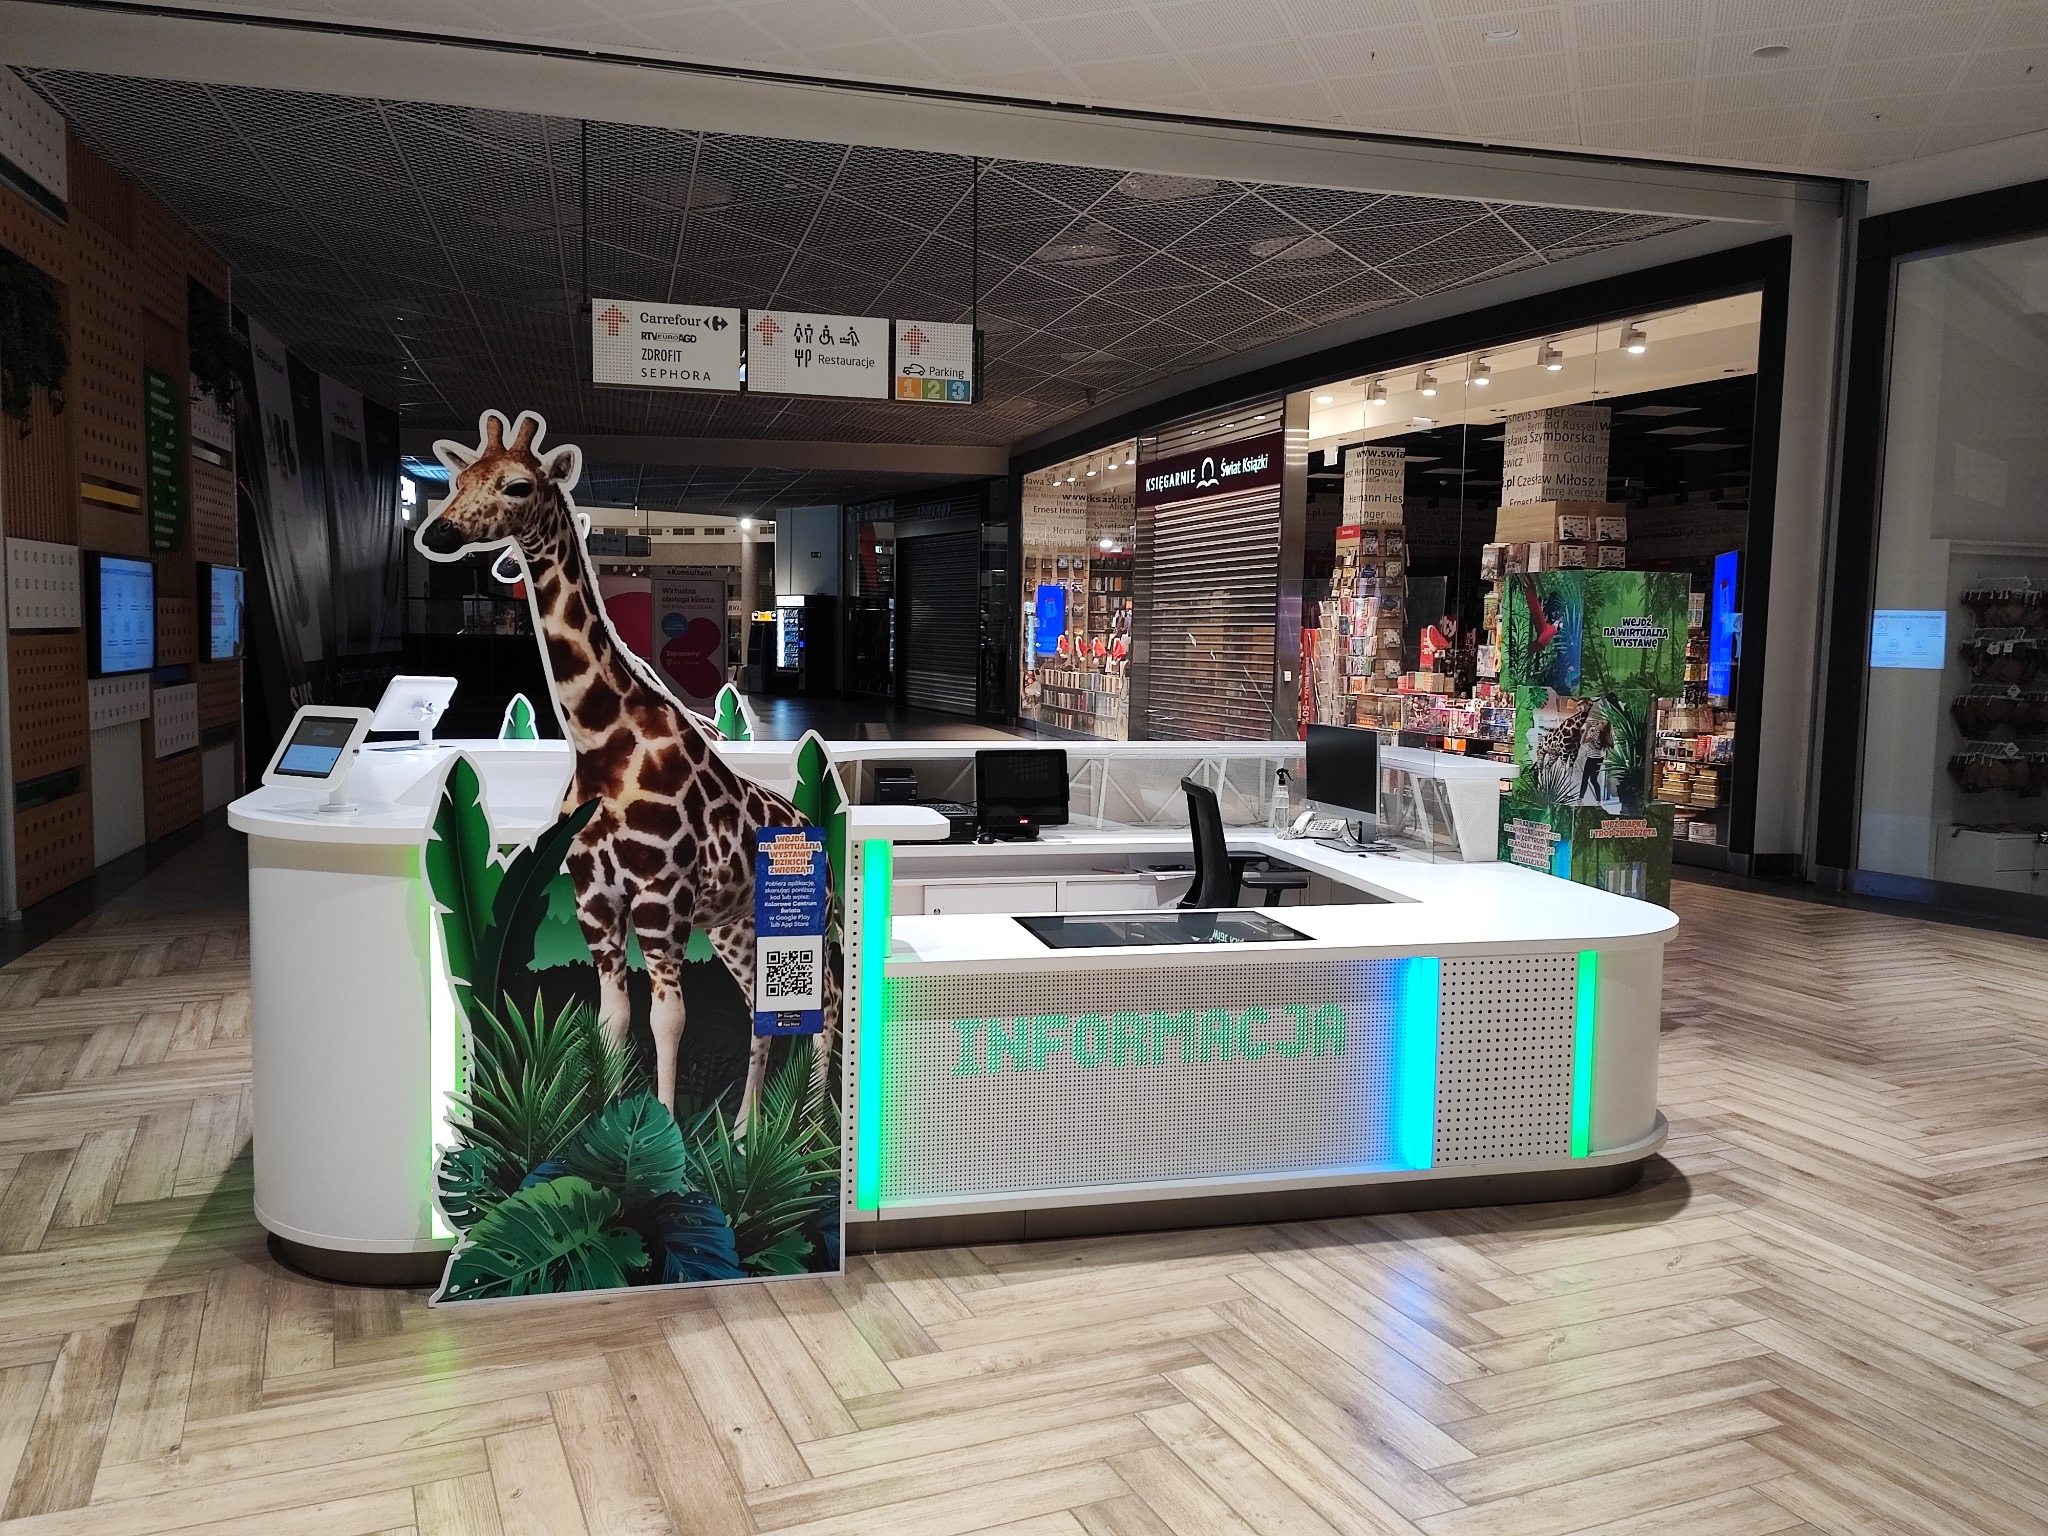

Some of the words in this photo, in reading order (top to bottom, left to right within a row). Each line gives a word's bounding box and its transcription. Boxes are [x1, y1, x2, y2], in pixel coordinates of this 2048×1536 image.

[640, 312, 702, 331] Carrefour
[641, 348, 682, 363] ZDROFIT
[818, 354, 875, 368] Restauracje
[641, 368, 711, 382] SEPHORA
[929, 366, 964, 379] Parking
[903, 378, 915, 398] 1
[927, 379, 940, 398] 2
[952, 381, 965, 400] 3
[1527, 420, 1560, 432] Bertrand
[1563, 420, 1598, 431] Russell
[1530, 430, 1595, 443] Szymborska
[1526, 452, 1559, 464] William
[1220, 457, 1241, 477] Świat
[1242, 453, 1269, 474] Książki
[1145, 468, 1196, 493] KSIĘGARNIE
[1517, 473, 1552, 487] Czesław
[1556, 473, 1595, 487] Miłosz
[1568, 486, 1605, 498] Kertész
[661, 587, 696, 595] Wirtualna
[661, 596, 690, 604] obsługa
[1613, 638, 1658, 650] WYSTAWĘ
[760, 843, 772, 851] NA
[773, 842, 821, 852] WIRTUALNĄ
[769, 850, 812, 859] WYSTAWĘ
[774, 858, 806, 866] DZIKICH
[775, 914, 797, 922] Google
[781, 921, 793, 929] App
[950, 1003, 1346, 1076] INFORMACJA
